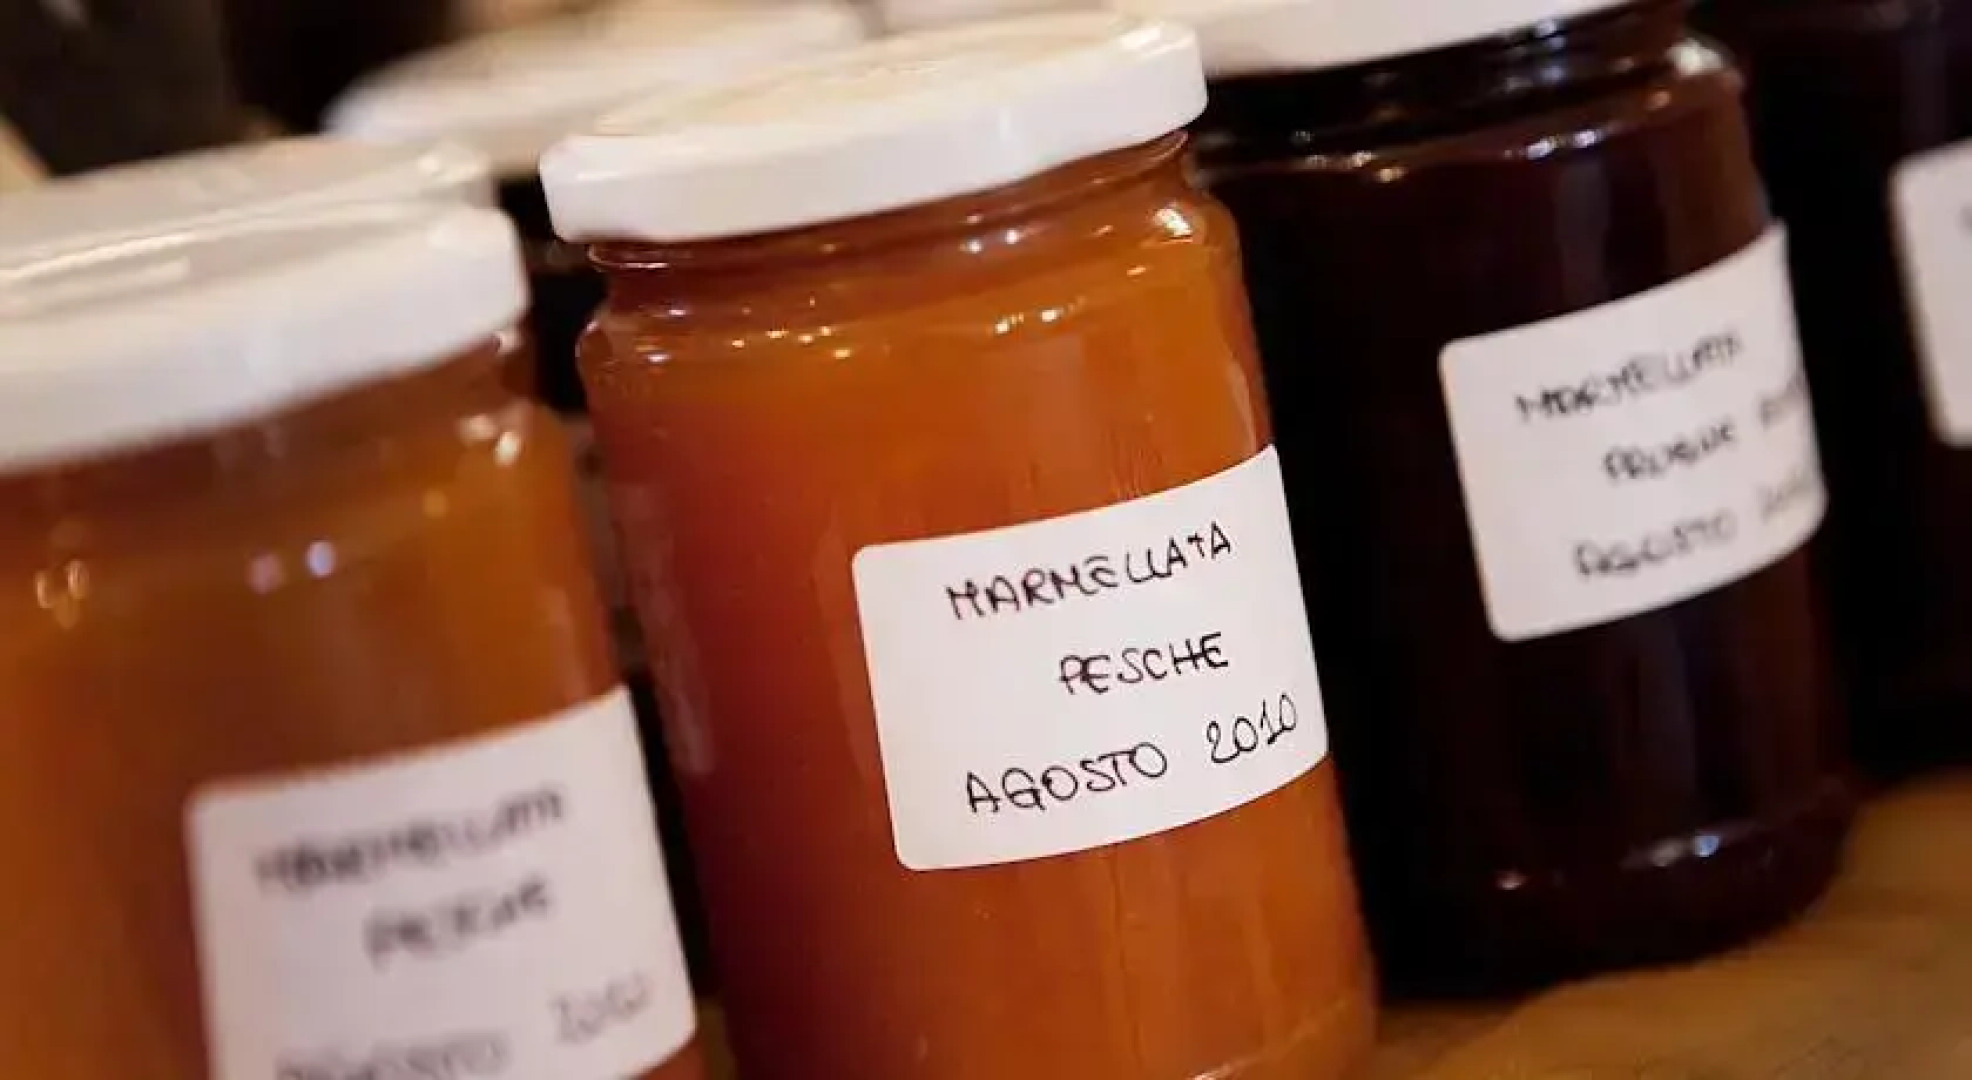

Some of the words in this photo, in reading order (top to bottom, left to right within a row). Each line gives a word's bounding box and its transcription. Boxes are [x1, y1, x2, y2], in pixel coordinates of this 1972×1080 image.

[945, 521, 1232, 620] MARMELLATA
[1058, 631, 1229, 695] PESCHE
[965, 741, 1168, 813] AGOSTO
[1206, 693, 1298, 765] 2010
